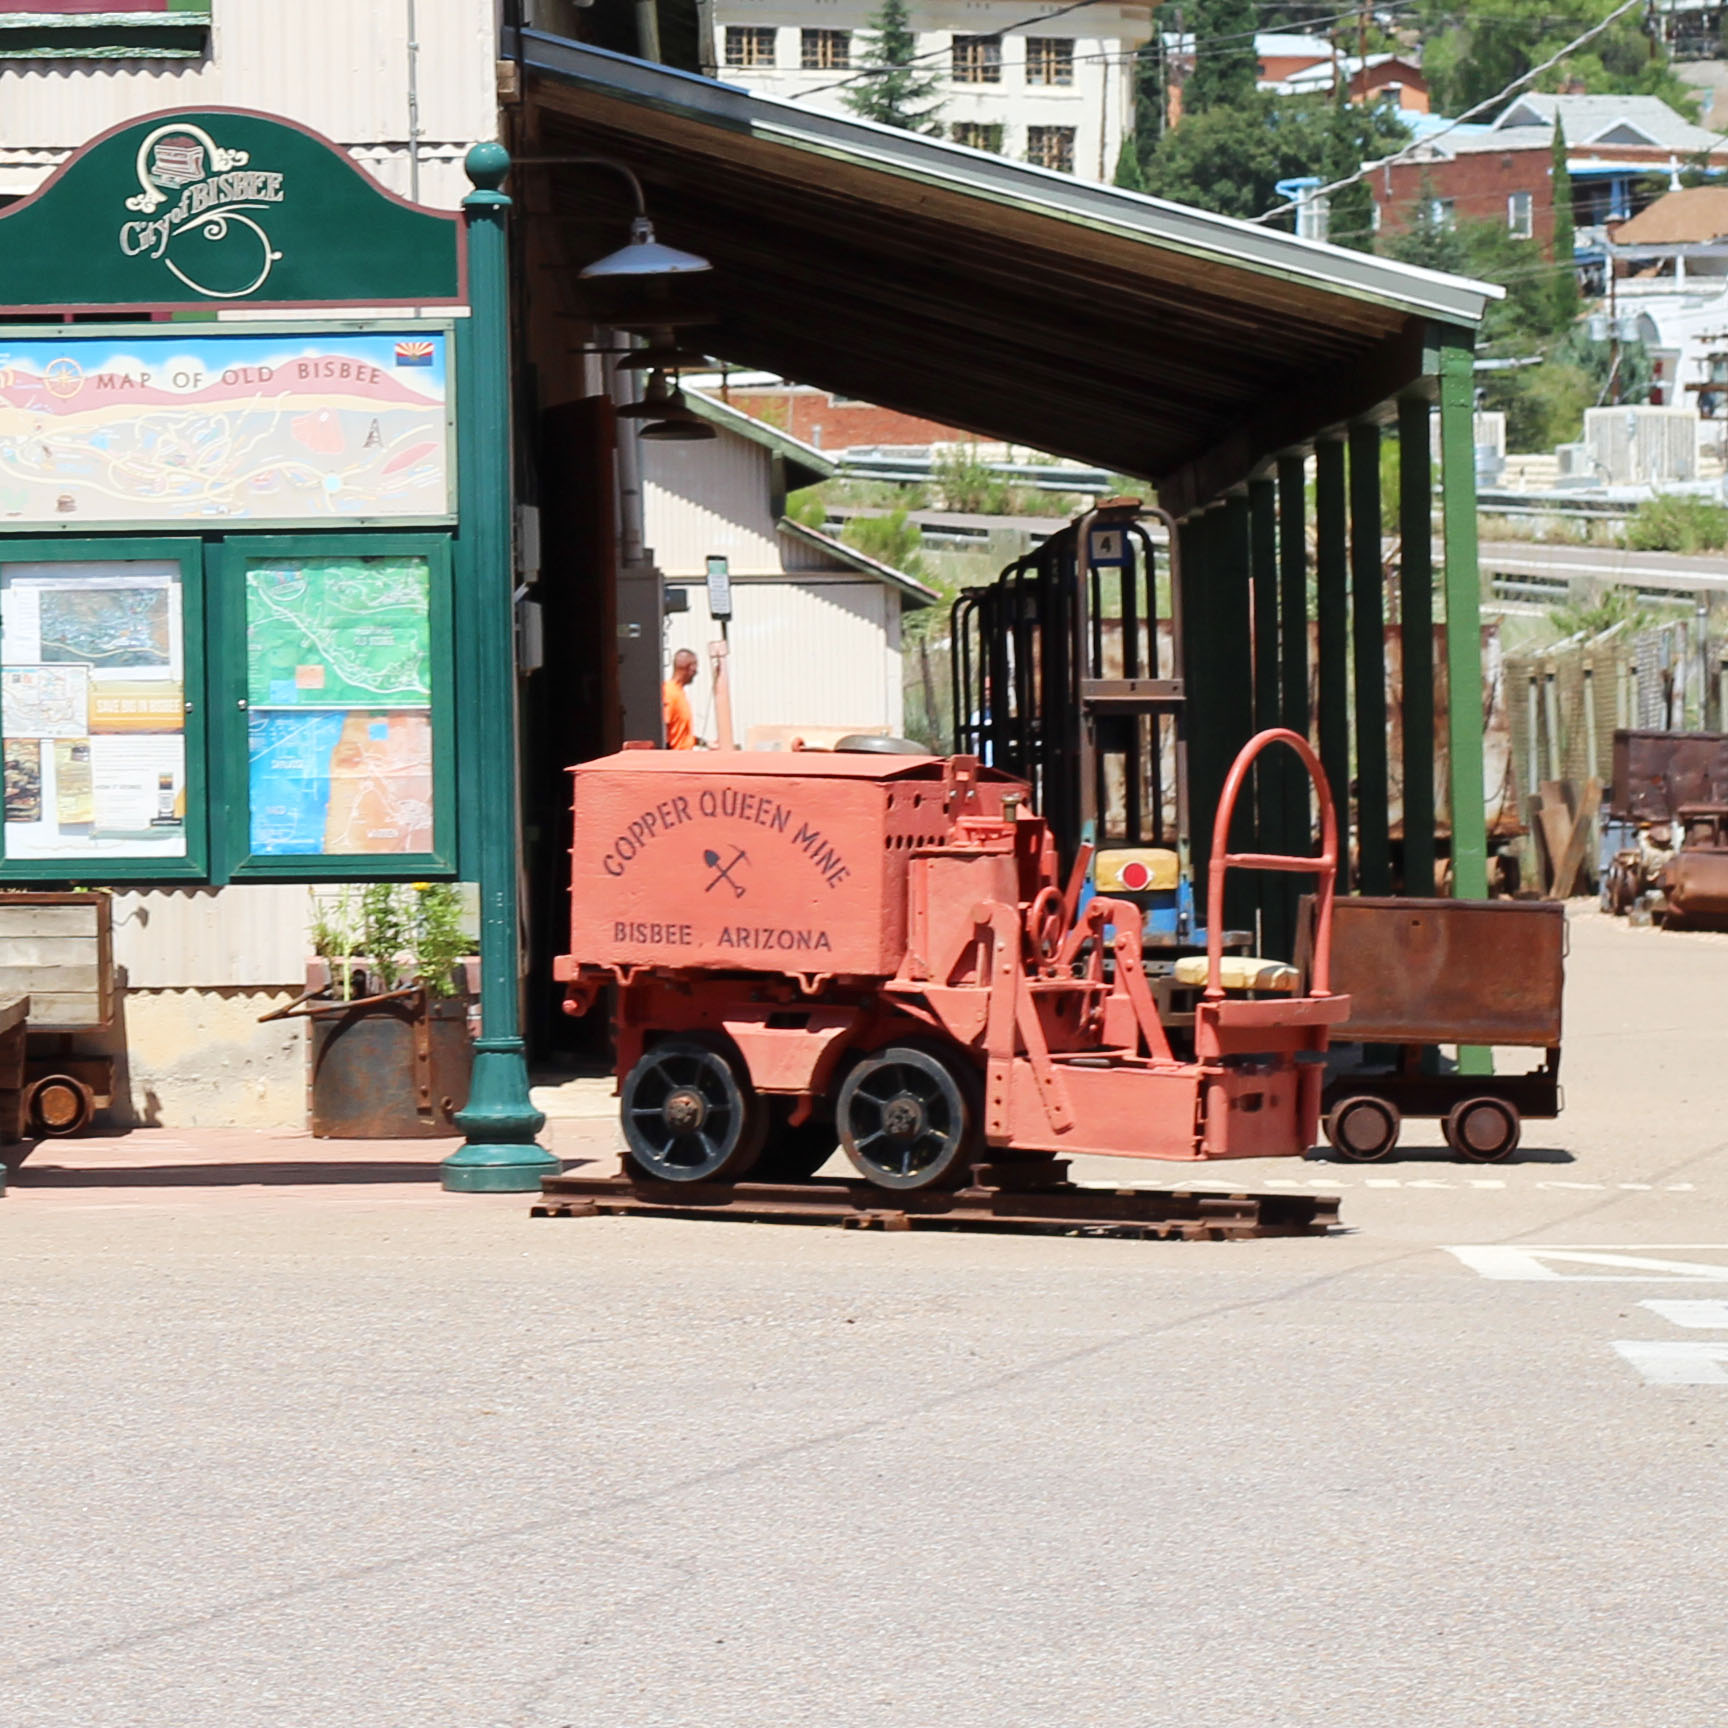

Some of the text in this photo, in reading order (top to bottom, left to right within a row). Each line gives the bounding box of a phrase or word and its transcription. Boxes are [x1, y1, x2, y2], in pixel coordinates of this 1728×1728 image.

[119, 171, 284, 260] City of BISBEE
[96, 361, 382, 389] MAP OF OLD BISBEE
[1100, 536, 1113, 553] 4
[604, 789, 851, 888] COPPER QUEEN MINE
[717, 927, 832, 952] ARIZONA
